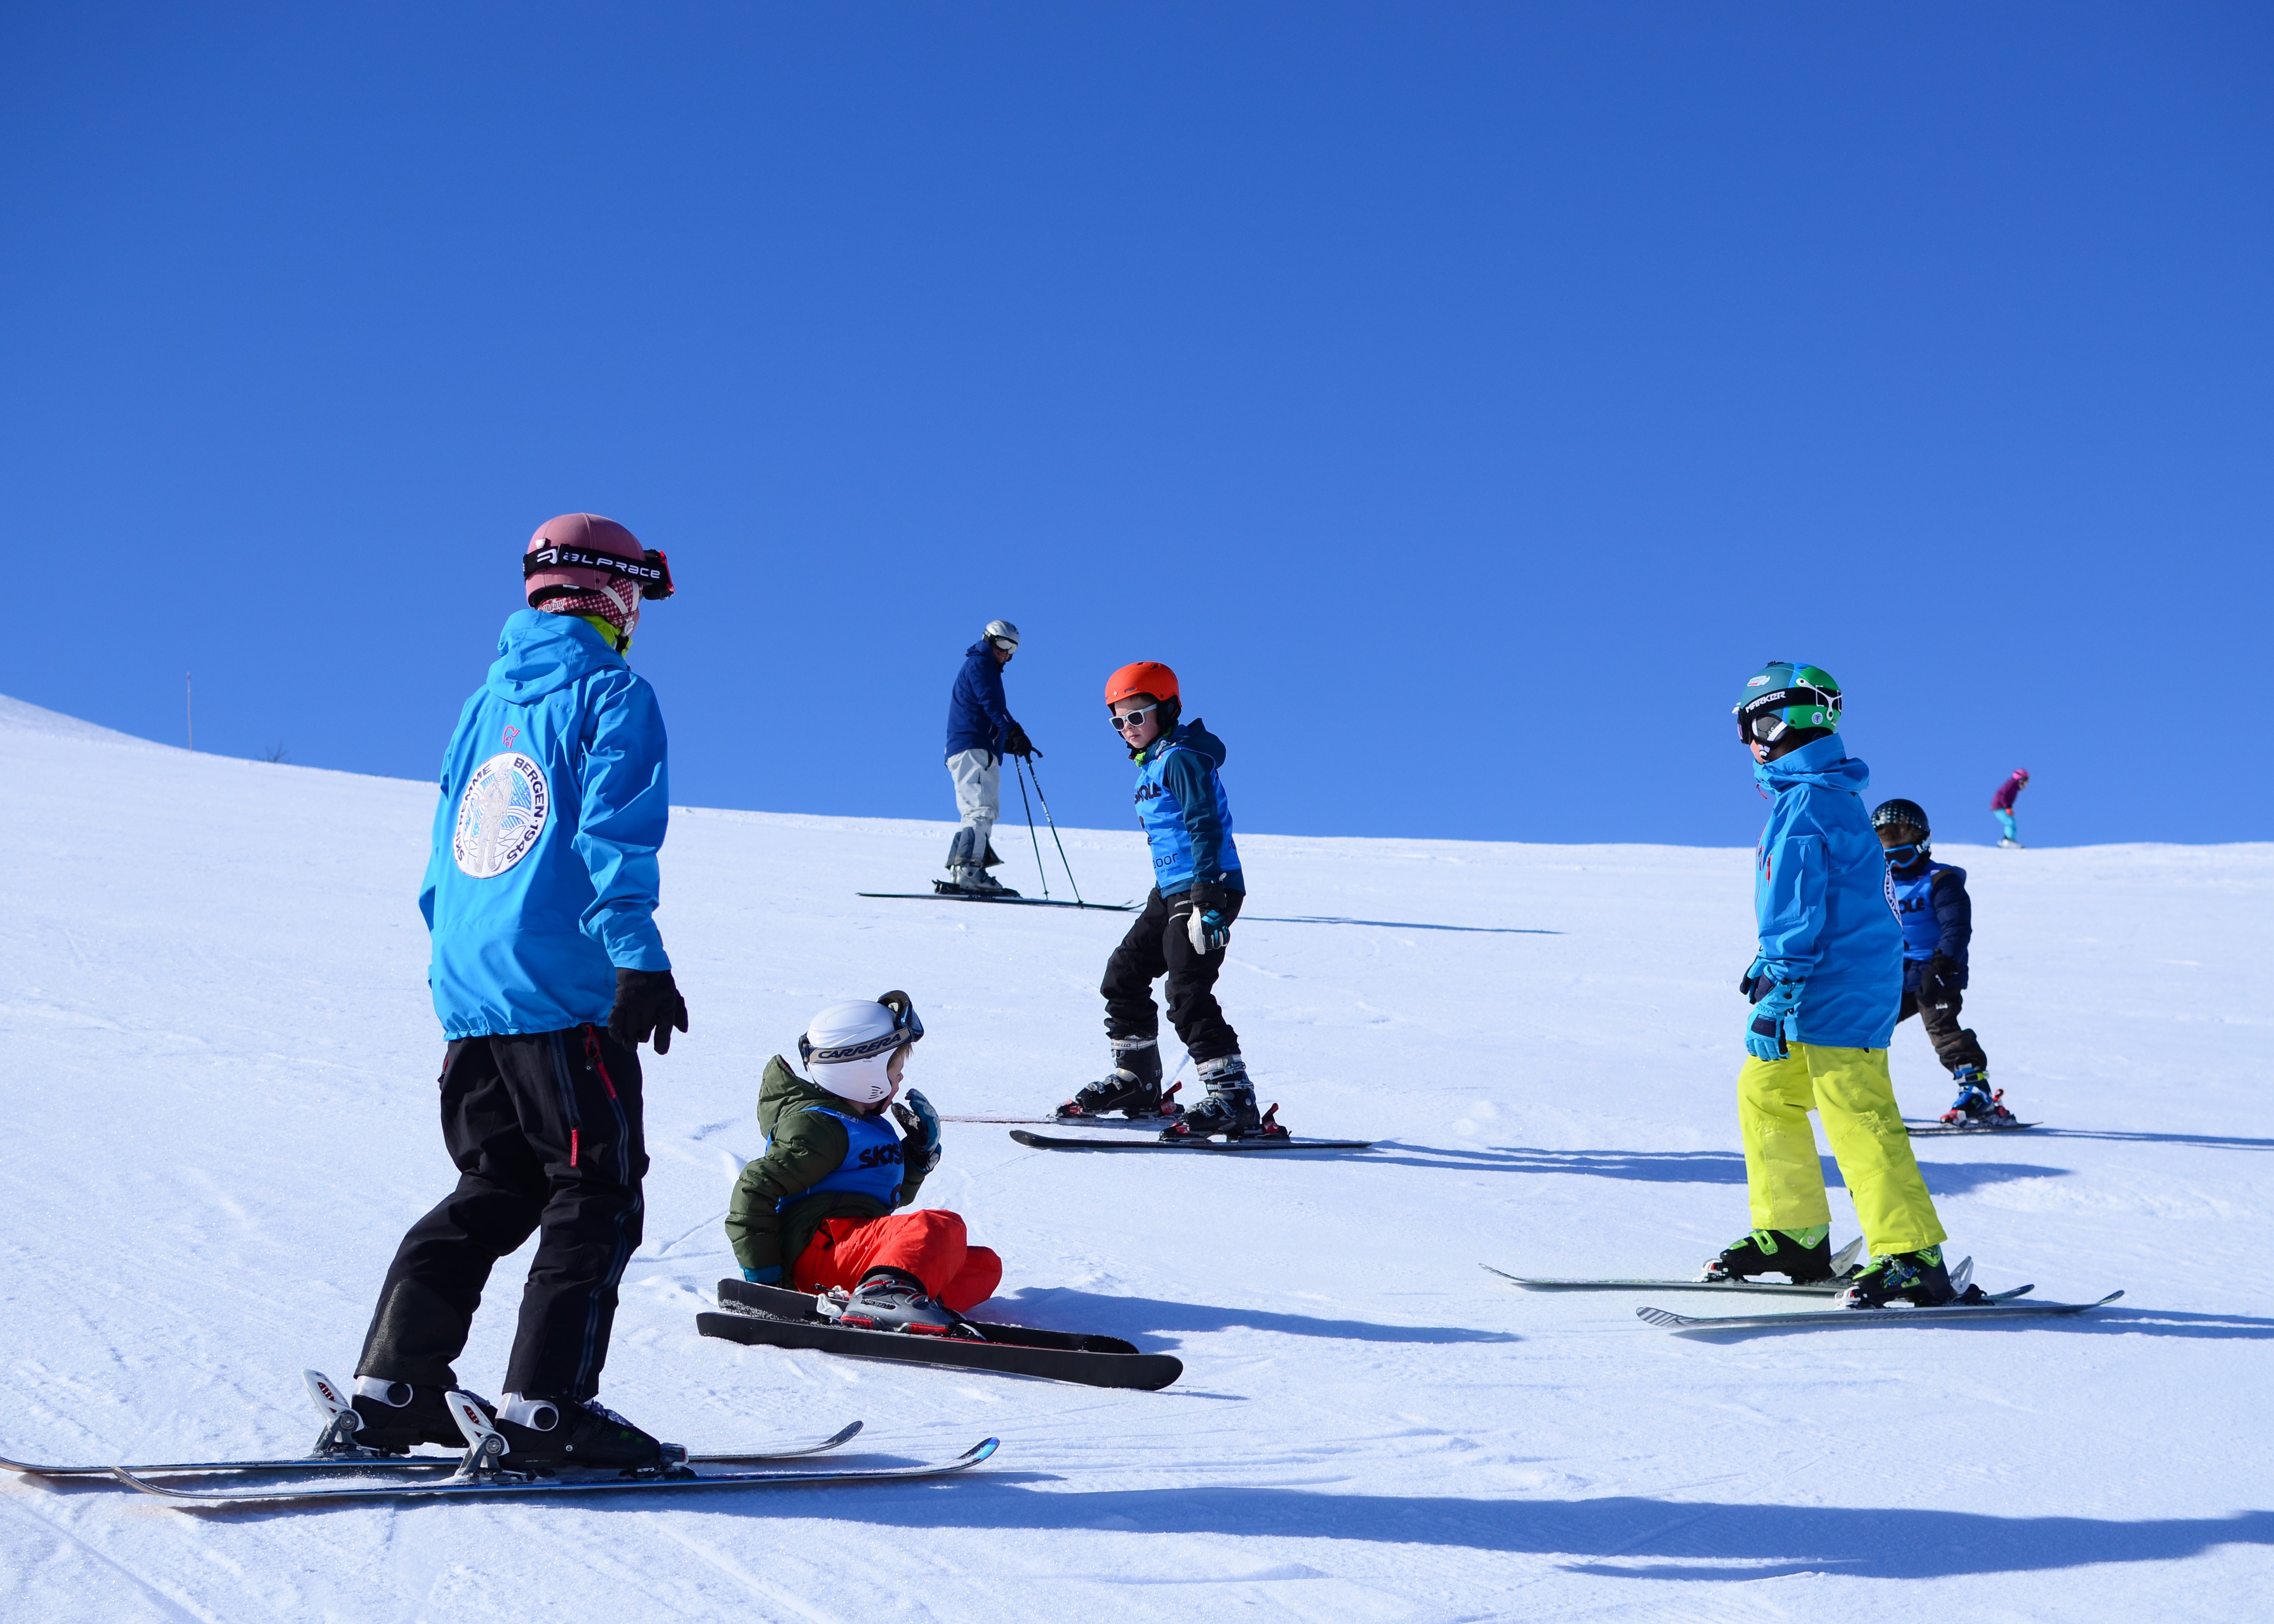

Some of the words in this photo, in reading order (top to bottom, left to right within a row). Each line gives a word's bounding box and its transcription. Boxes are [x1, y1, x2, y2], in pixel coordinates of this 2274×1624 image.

[1745, 691, 1786, 713] MARKER
[513, 757, 545, 818] BERGEN
[507, 823, 539, 863] 1945
[818, 1033, 902, 1059] CARRERA
